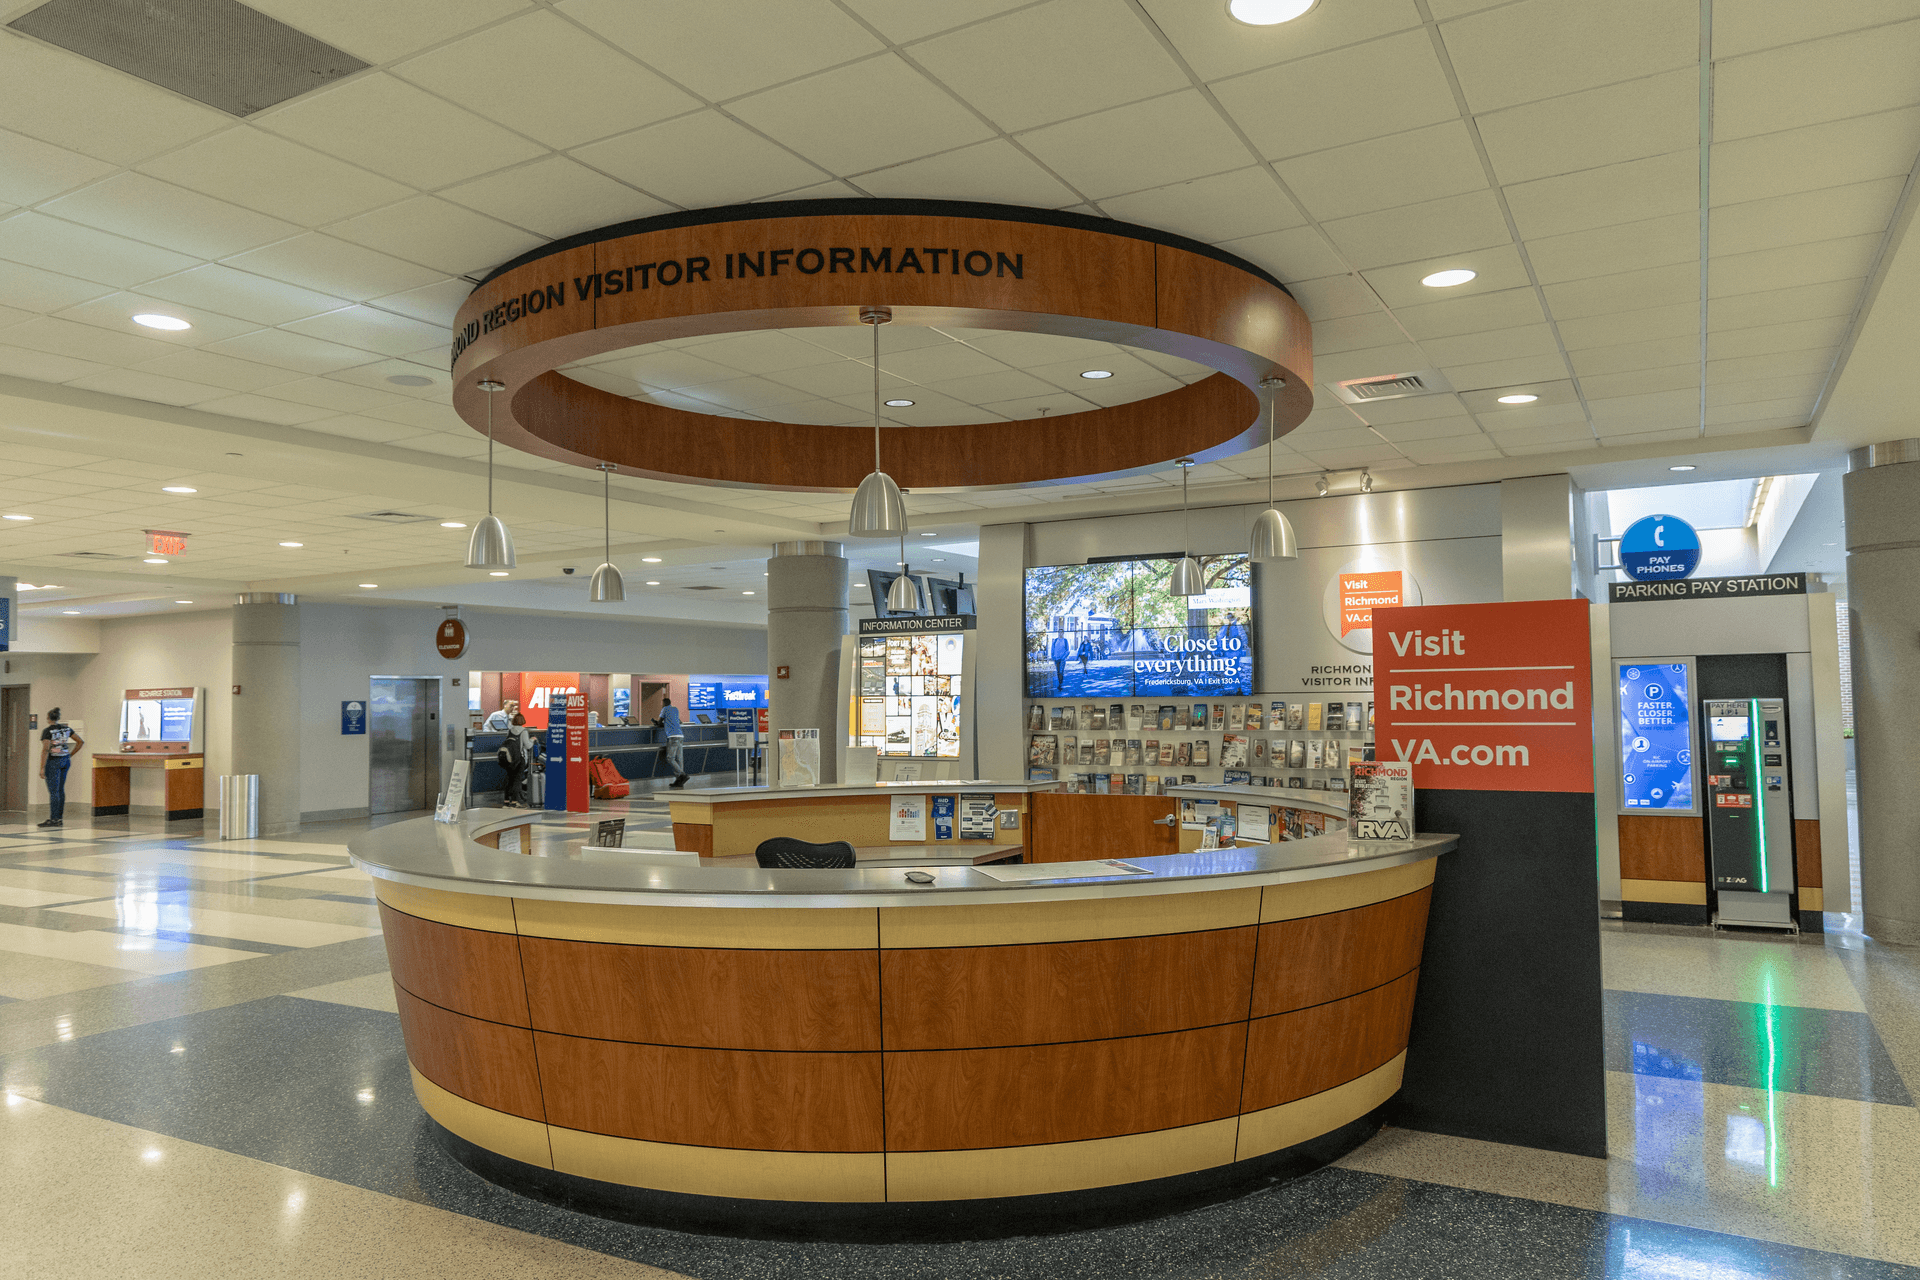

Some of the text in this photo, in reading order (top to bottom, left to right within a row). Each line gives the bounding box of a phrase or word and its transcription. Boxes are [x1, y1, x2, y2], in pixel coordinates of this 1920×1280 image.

[482, 281, 564, 336] REGION
[573, 256, 710, 301] VISITOR
[726, 247, 1024, 280] INFORMATION
[1649, 556, 1671, 564] PAY
[1636, 564, 1685, 574] PHONES
[1344, 580, 1369, 589] Visit
[1616, 576, 1799, 598] PARKING PAY STATION
[1345, 595, 1399, 606] Richmond
[1346, 613, 1372, 622] VA.c
[863, 618, 963, 631] INFORMATION CENTER
[1164, 635, 1242, 653] Close to
[1388, 629, 1465, 657] Visit
[1134, 655, 1242, 676] everything.
[1311, 665, 1371, 674] RICHMON
[1145, 678, 1193, 686] Fredericksburg,
[1302, 677, 1351, 686] VISITOR
[567, 695, 585, 707] AVIS
[1389, 681, 1574, 711] Richmond
[1638, 709, 1676, 717] CLOSER.
[1638, 717, 1676, 725] BETTER.
[1391, 739, 1529, 766] VA.com
[1355, 767, 1408, 777] RICHMOND
[1357, 820, 1408, 839] RVA
